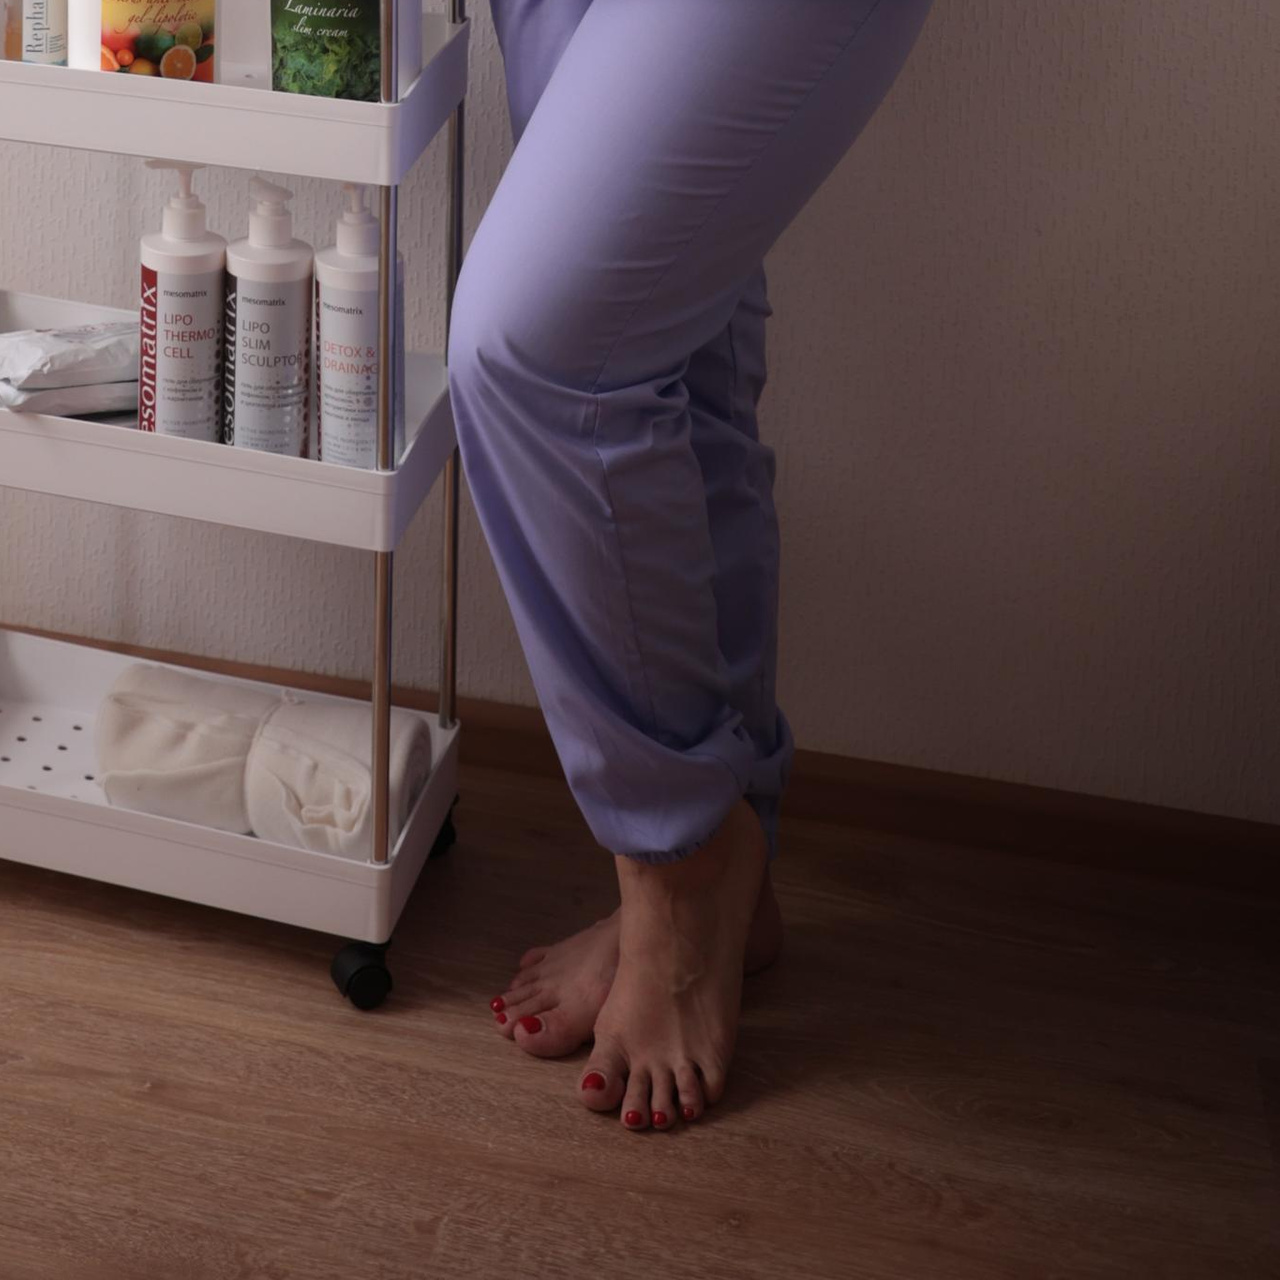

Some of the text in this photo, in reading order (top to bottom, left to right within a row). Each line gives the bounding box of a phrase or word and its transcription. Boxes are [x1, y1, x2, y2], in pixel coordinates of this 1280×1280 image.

[291, 15, 349, 38] slim cream
[163, 289, 208, 299] mesomatrix
[241, 295, 286, 307] mesomatrix
[322, 301, 364, 316] mesomatrix
[163, 313, 193, 327] LIPO
[241, 319, 271, 335] LIPO
[163, 327, 216, 343] THERMO
[241, 336, 271, 351] SLIM
[323, 340, 376, 359] DETOX &
[140, 282, 157, 433] esomatrix
[163, 345, 195, 360] CELL
[323, 357, 379, 375] DRAINAG
